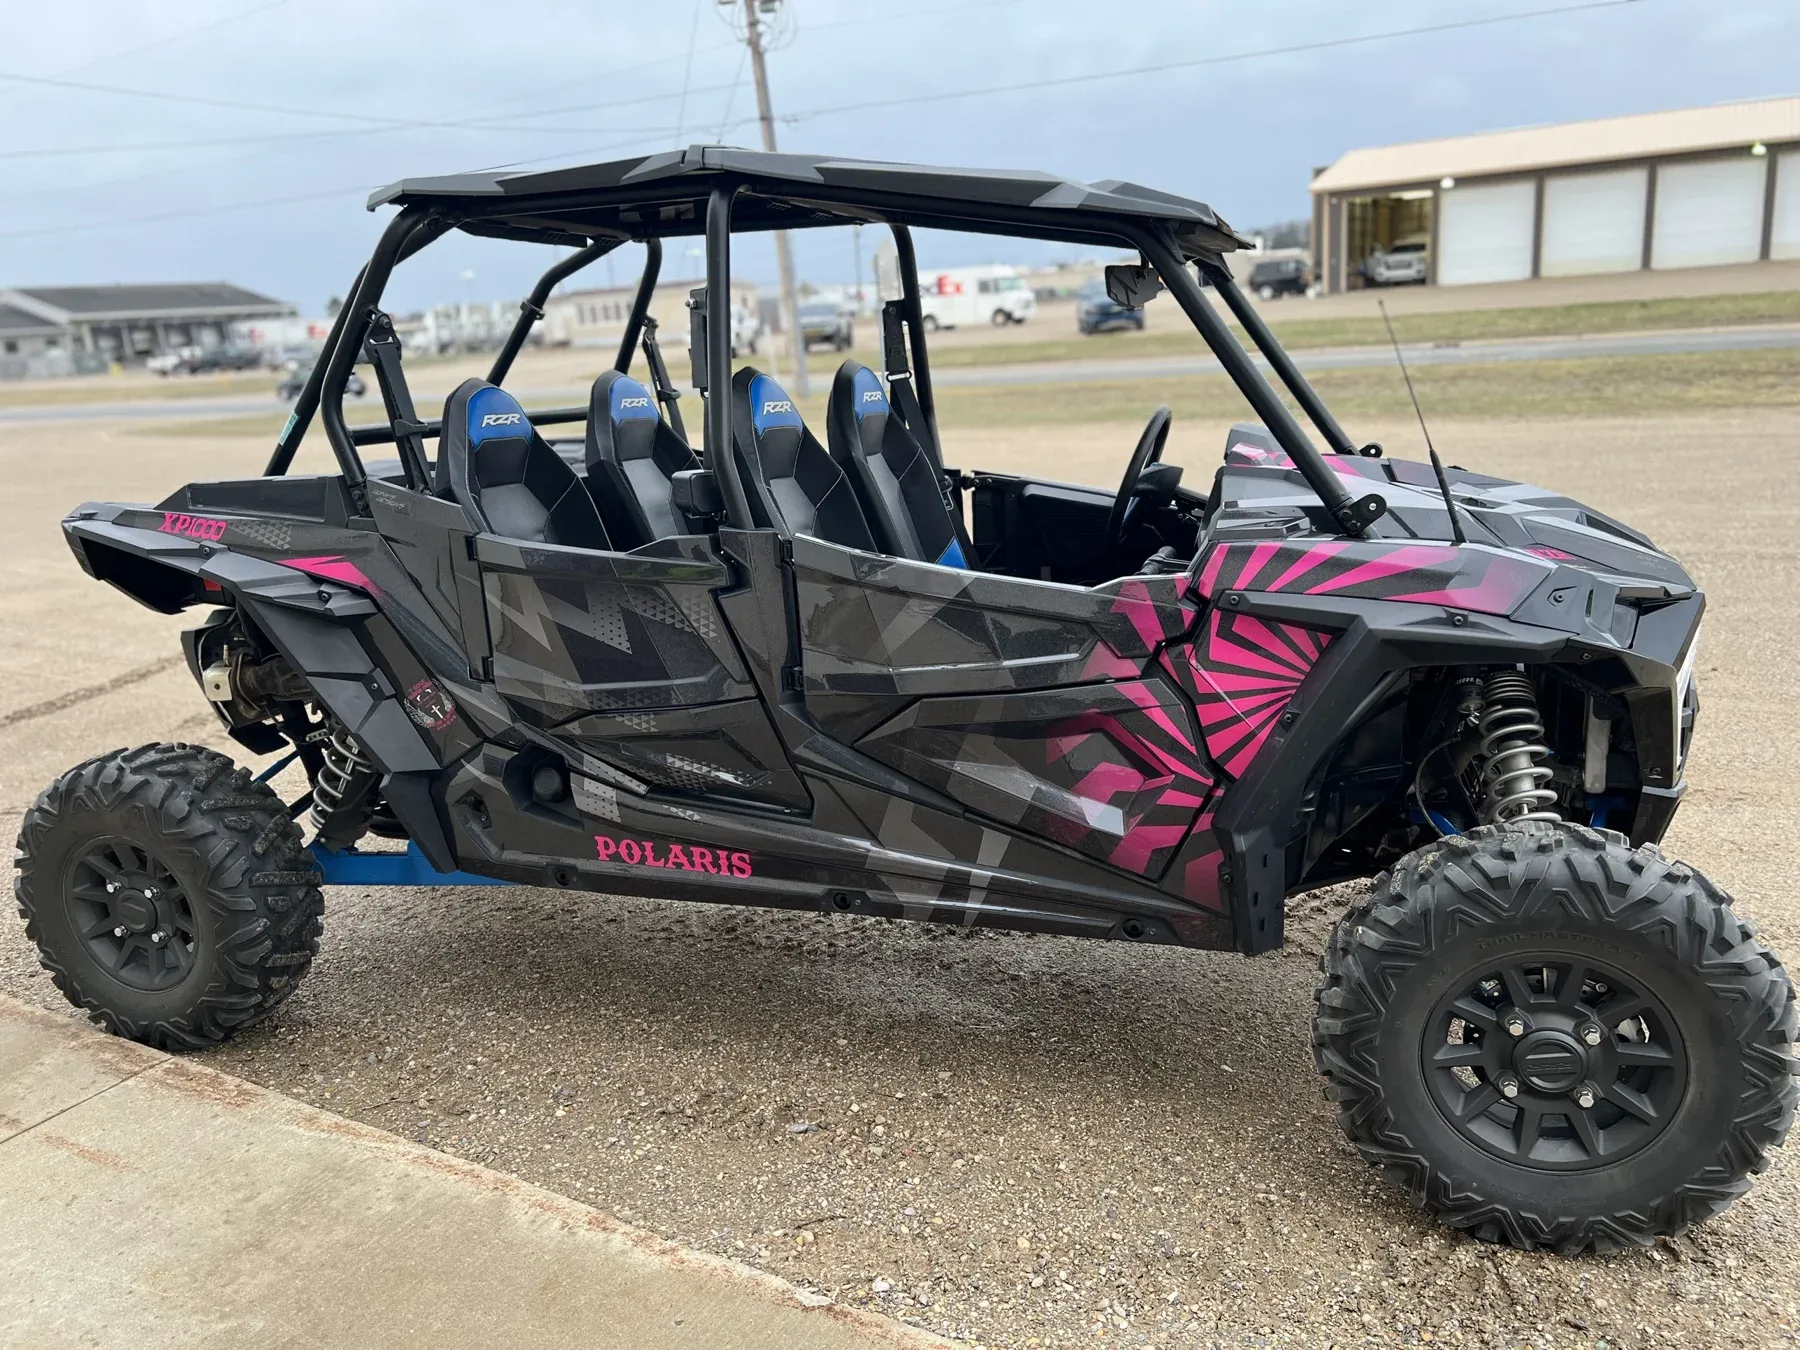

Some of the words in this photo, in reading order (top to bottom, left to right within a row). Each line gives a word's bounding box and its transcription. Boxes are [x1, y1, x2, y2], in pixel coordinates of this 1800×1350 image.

[621, 397, 648, 410] RZR
[863, 391, 882, 403] RZR
[763, 401, 792, 415] RZR
[481, 413, 520, 428] RZR
[158, 512, 227, 541] XP1000
[594, 835, 753, 879] POLARIS
